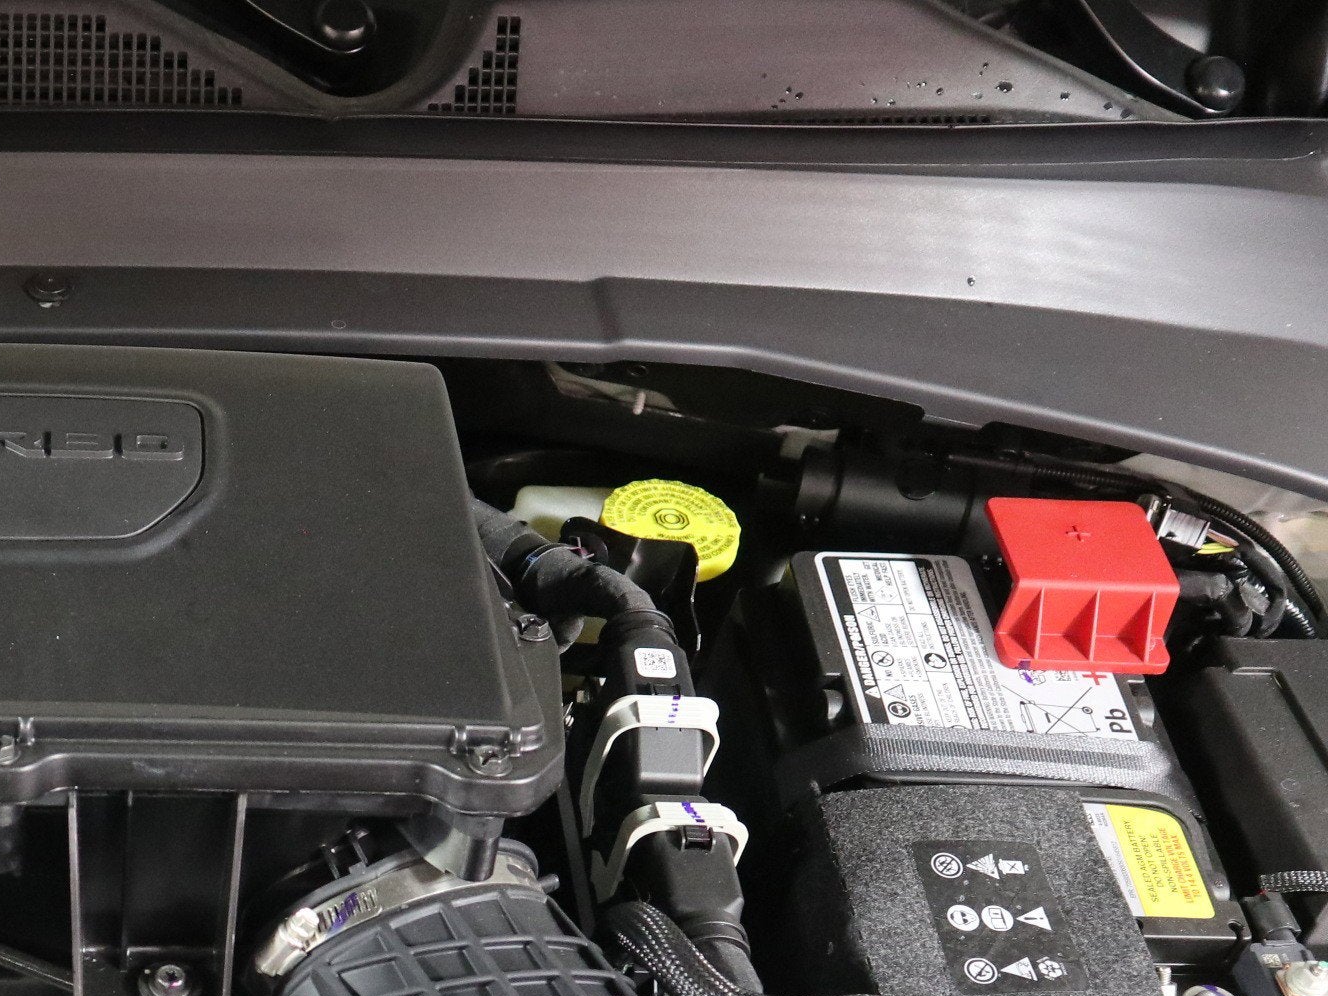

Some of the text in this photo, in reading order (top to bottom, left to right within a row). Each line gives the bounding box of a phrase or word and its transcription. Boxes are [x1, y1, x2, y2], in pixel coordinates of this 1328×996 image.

[1104, 708, 1133, 734] Pb
[1124, 820, 1140, 855] BATTERY
[1143, 872, 1159, 902] SEALED
